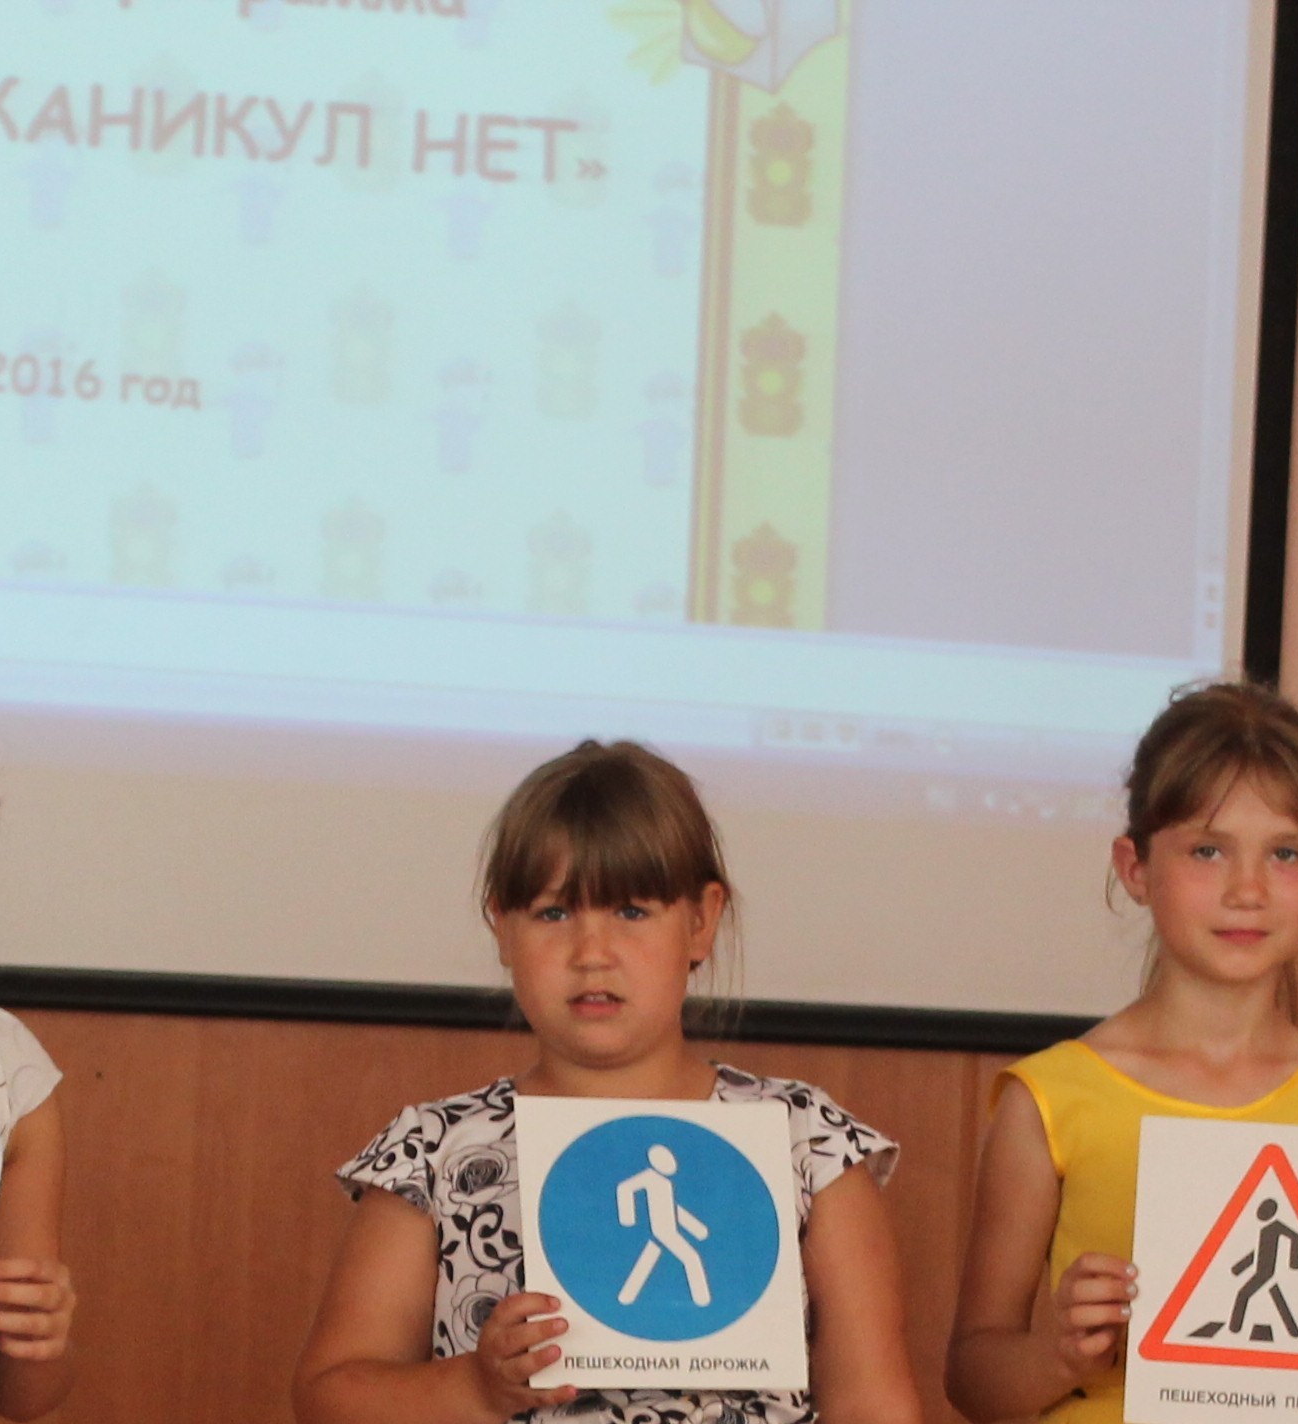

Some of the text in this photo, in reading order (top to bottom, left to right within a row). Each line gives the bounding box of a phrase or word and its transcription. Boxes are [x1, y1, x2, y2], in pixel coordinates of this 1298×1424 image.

[411, 109, 608, 187] НЕТ»
[119, 366, 204, 412] год
[563, 1355, 770, 1372] ПЕШЕХОДНАЯ ДОРОЖКА
[1159, 1388, 1276, 1408] ПЕШЕХОДНЫЙ
